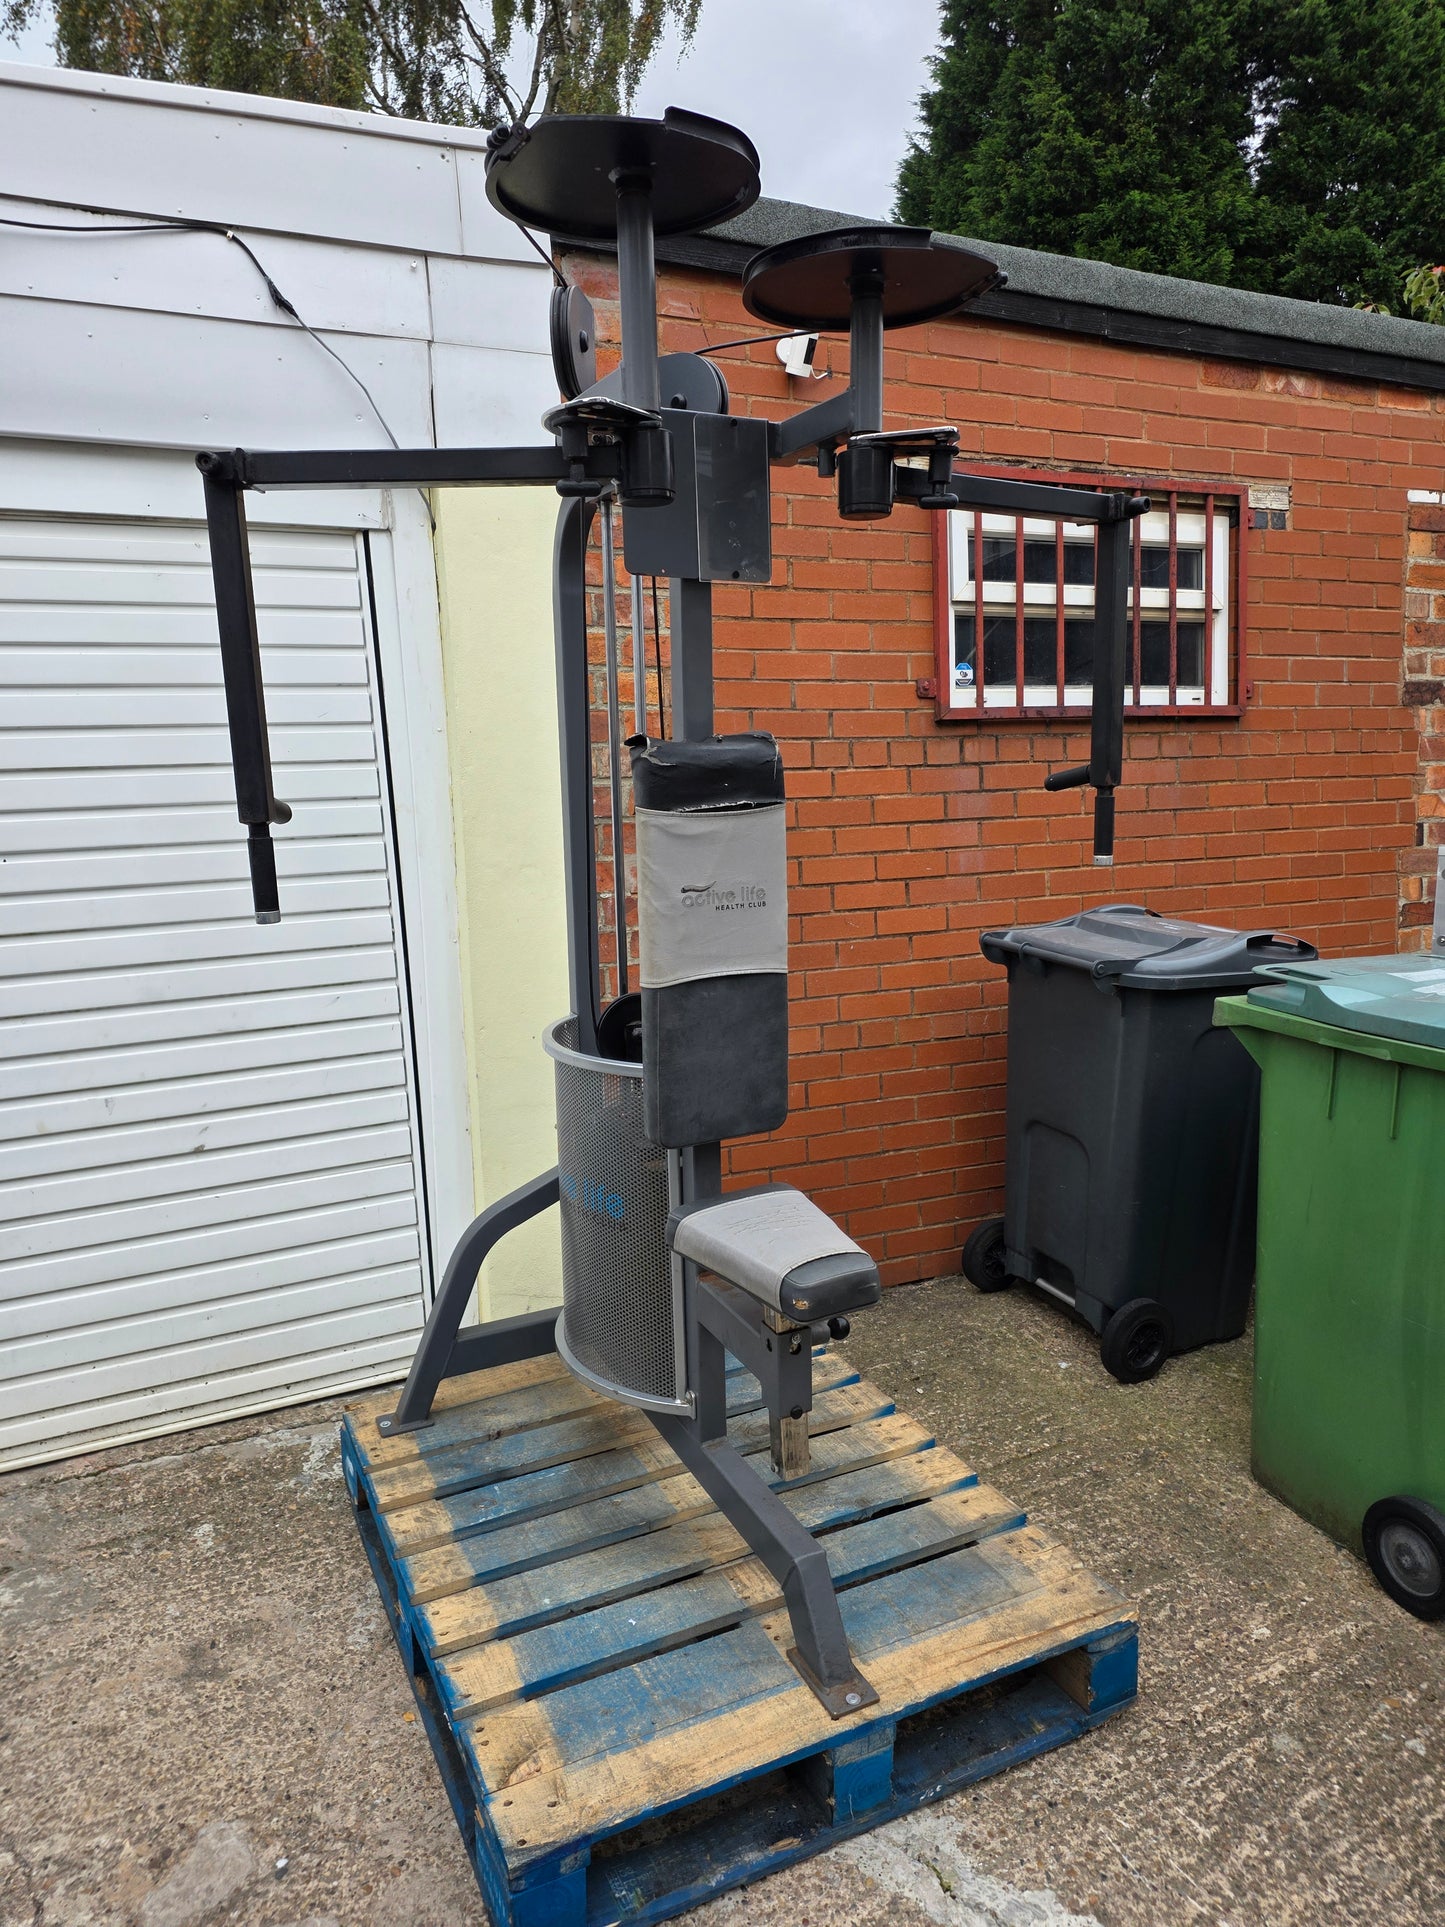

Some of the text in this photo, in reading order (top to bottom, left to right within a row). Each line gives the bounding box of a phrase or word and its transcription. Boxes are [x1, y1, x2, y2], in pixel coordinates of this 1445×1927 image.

[682, 885, 766, 908] active life
[715, 900, 767, 911] HEALTH CLUB
